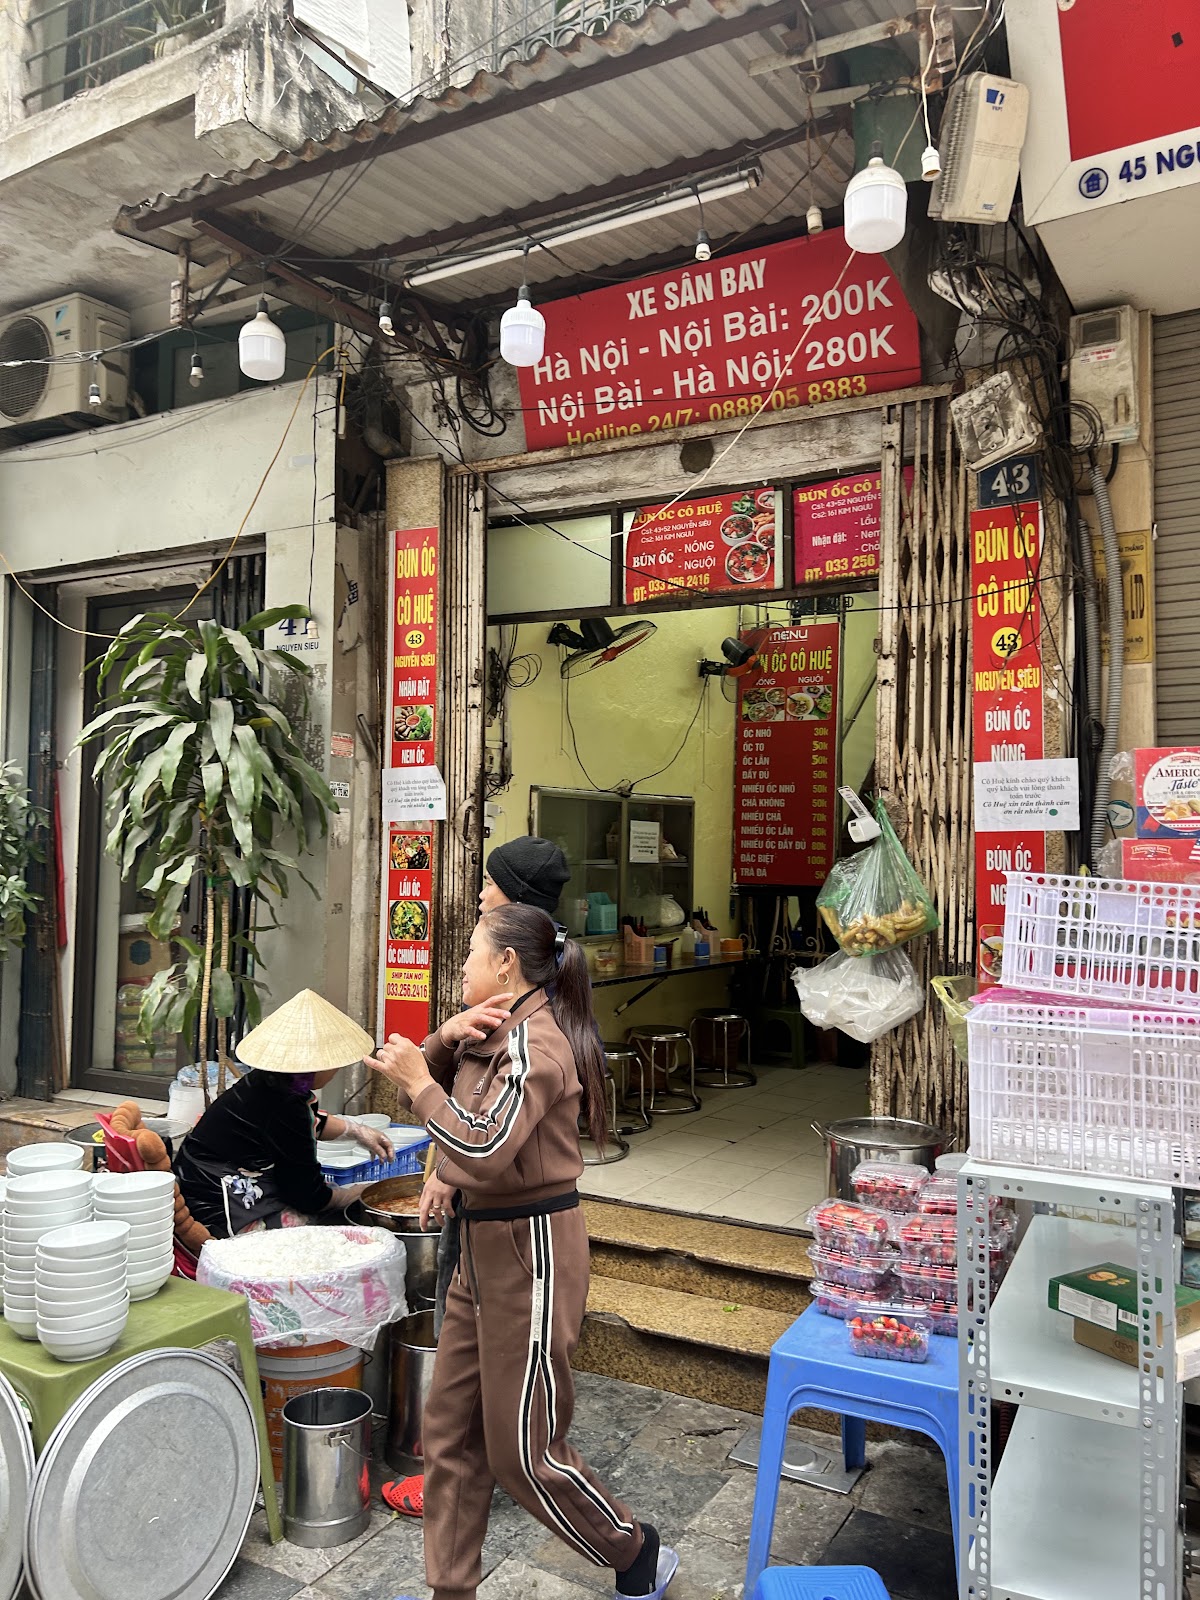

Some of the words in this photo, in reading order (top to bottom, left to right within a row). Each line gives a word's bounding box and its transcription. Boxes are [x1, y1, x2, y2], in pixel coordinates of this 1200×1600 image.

[1119, 155, 1147, 184] 45
[626, 285, 657, 321] XE
[664, 271, 714, 311] SÂN
[720, 258, 767, 299] BAY
[533, 354, 571, 386] Hà
[581, 337, 629, 377] Nội
[659, 319, 712, 359] Nội
[723, 304, 789, 344] Bài:
[801, 276, 893, 327] 200K
[537, 391, 585, 427] Nội
[594, 378, 643, 415] Bài
[673, 363, 716, 398] Hà
[726, 348, 793, 388] Nội:
[805, 324, 897, 372] 280K
[567, 421, 642, 446] Hotline
[648, 408, 701, 433] 24/7:
[709, 397, 763, 422] 0888
[771, 389, 800, 411] 05
[808, 374, 868, 403] 8383
[798, 488, 828, 503] BÚN
[831, 482, 850, 498] ỐC
[852, 479, 872, 493] CÔ
[991, 463, 1030, 498] 43
[677, 505, 694, 518] CÔ
[696, 500, 723, 515] HUỆ
[838, 506, 851, 515] KIM
[684, 539, 714, 553] NÓNG
[812, 534, 831, 547] Nhận
[832, 532, 847, 545] đặt:
[975, 521, 1009, 564] BÚN
[1013, 512, 1036, 559] ỐC
[397, 541, 418, 579] BÚN
[421, 536, 436, 577] ỐC
[632, 552, 656, 568] BÚN
[658, 547, 675, 564] ỐC
[684, 555, 716, 570] NGUỘI
[825, 558, 849, 573] 033
[851, 553, 875, 569] 256
[633, 586, 647, 603] ĐT:
[648, 579, 666, 592] 033
[667, 576, 684, 590] 256
[686, 573, 710, 588] 2416
[977, 574, 999, 618] CÔ
[1003, 570, 1036, 620] HUỆ
[397, 590, 412, 626] CÔ
[414, 588, 434, 631] HUỆ
[407, 634, 422, 645] 43
[995, 633, 1019, 651] 43
[394, 651, 420, 669] NGUYỄN
[420, 651, 436, 668] SIÊU
[771, 646, 787, 673] ỐC
[790, 647, 806, 672] CÔ
[809, 645, 833, 674] HUỆ
[797, 674, 824, 685] NGUỘI
[1017, 663, 1040, 689] SIÊU
[398, 676, 417, 701] NHẬN
[417, 676, 430, 700] ĐẶT
[985, 706, 1011, 732] BÚN
[1014, 701, 1031, 731] ỐC
[743, 728, 754, 738] ỐC
[401, 749, 415, 764] NEM
[416, 743, 425, 764] ỐC
[743, 742, 754, 752] ỐC
[755, 743, 765, 752] TO
[991, 740, 1026, 763] NÓNG
[1155, 767, 1200, 778] AMERIC
[1031, 784, 1046, 792] lòng
[1170, 778, 1199, 792] Taste
[993, 801, 1007, 809] Huệ
[986, 845, 1011, 871] BÚN
[1015, 841, 1032, 871] ỐC
[399, 875, 411, 897] LẨU
[412, 876, 421, 897] ỐC
[387, 943, 397, 963] ỐC
[397, 944, 416, 964] CHUỐI
[416, 946, 429, 968] ĐẬU
[386, 982, 428, 998] 033.256.2416
